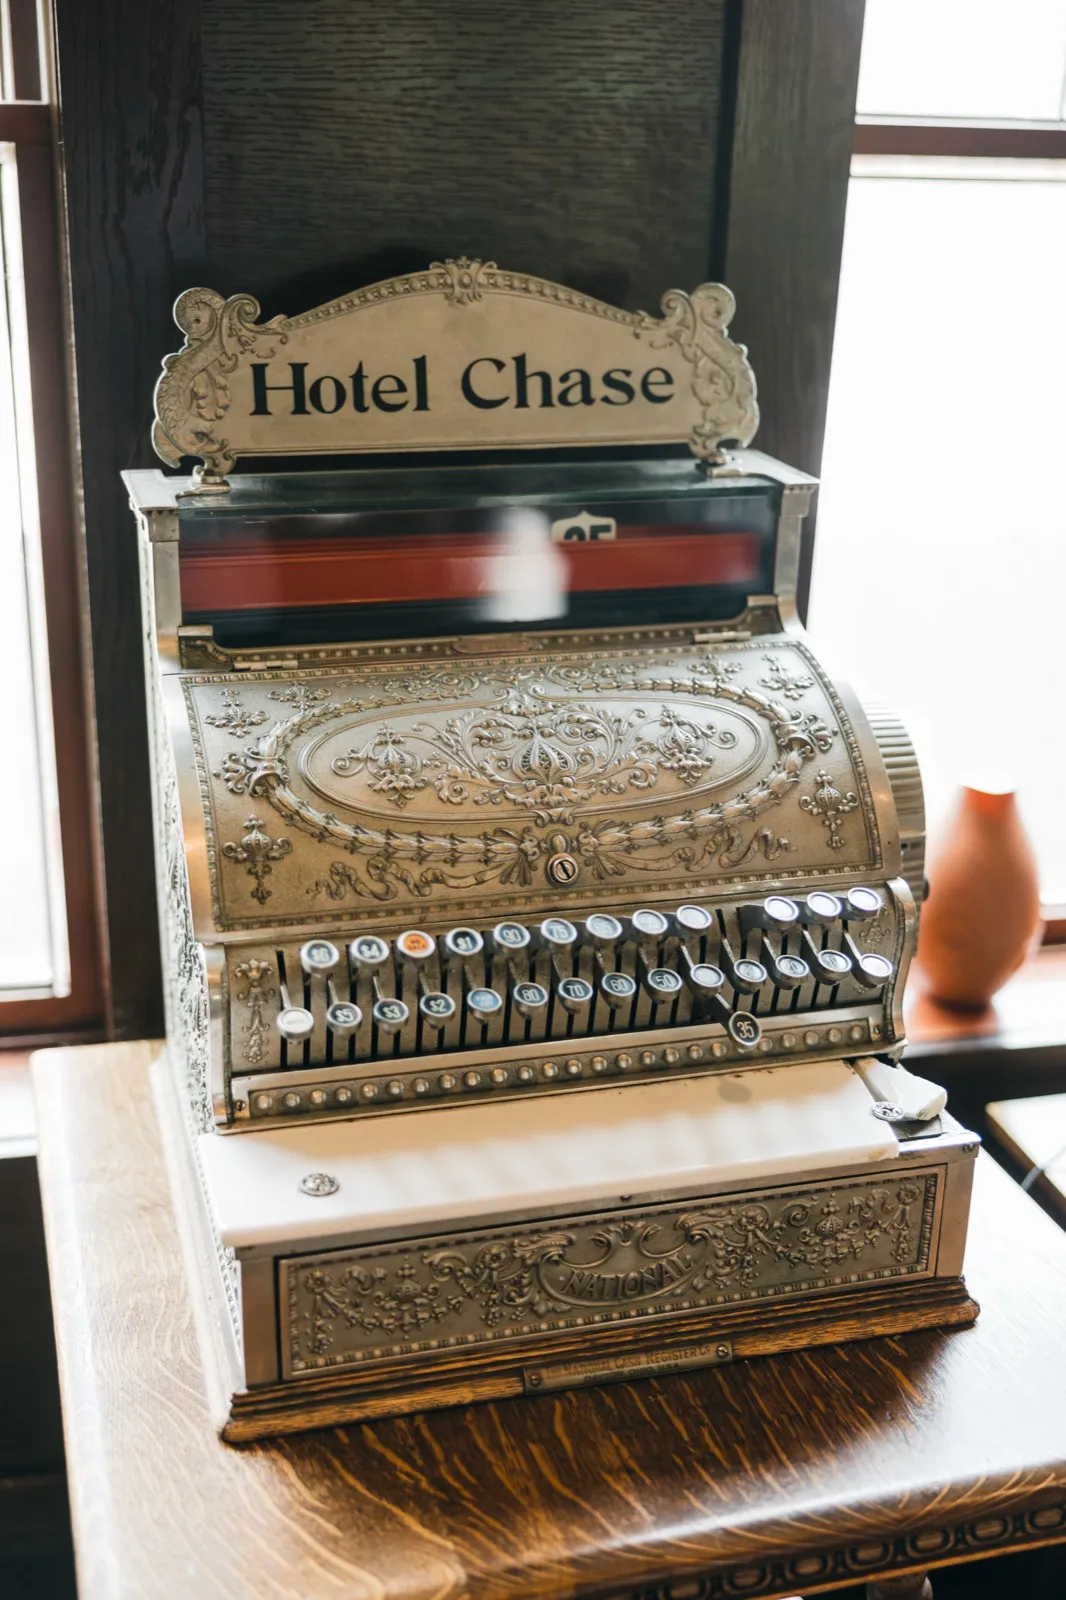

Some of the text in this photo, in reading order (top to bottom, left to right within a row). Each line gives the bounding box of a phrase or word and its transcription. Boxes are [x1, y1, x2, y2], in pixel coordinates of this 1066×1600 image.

[249, 353, 675, 416] Hotel Chase
[504, 930, 521, 942] 90
[552, 925, 568, 939] 75
[456, 936, 473, 950] $1
[360, 943, 380, 958] $4
[612, 979, 628, 991] 60
[657, 976, 673, 988] 50
[523, 989, 540, 1001] 80
[568, 986, 585, 997] 70
[384, 1006, 401, 1018] $3
[430, 1000, 447, 1012] $2
[336, 1009, 354, 1022] $5
[737, 1021, 754, 1038] 35
[560, 1254, 695, 1300] NATIONAL
[563, 1360, 612, 1376] NATIONAL
[614, 1355, 641, 1370] CASH
[646, 1347, 697, 1365] REGISTER
